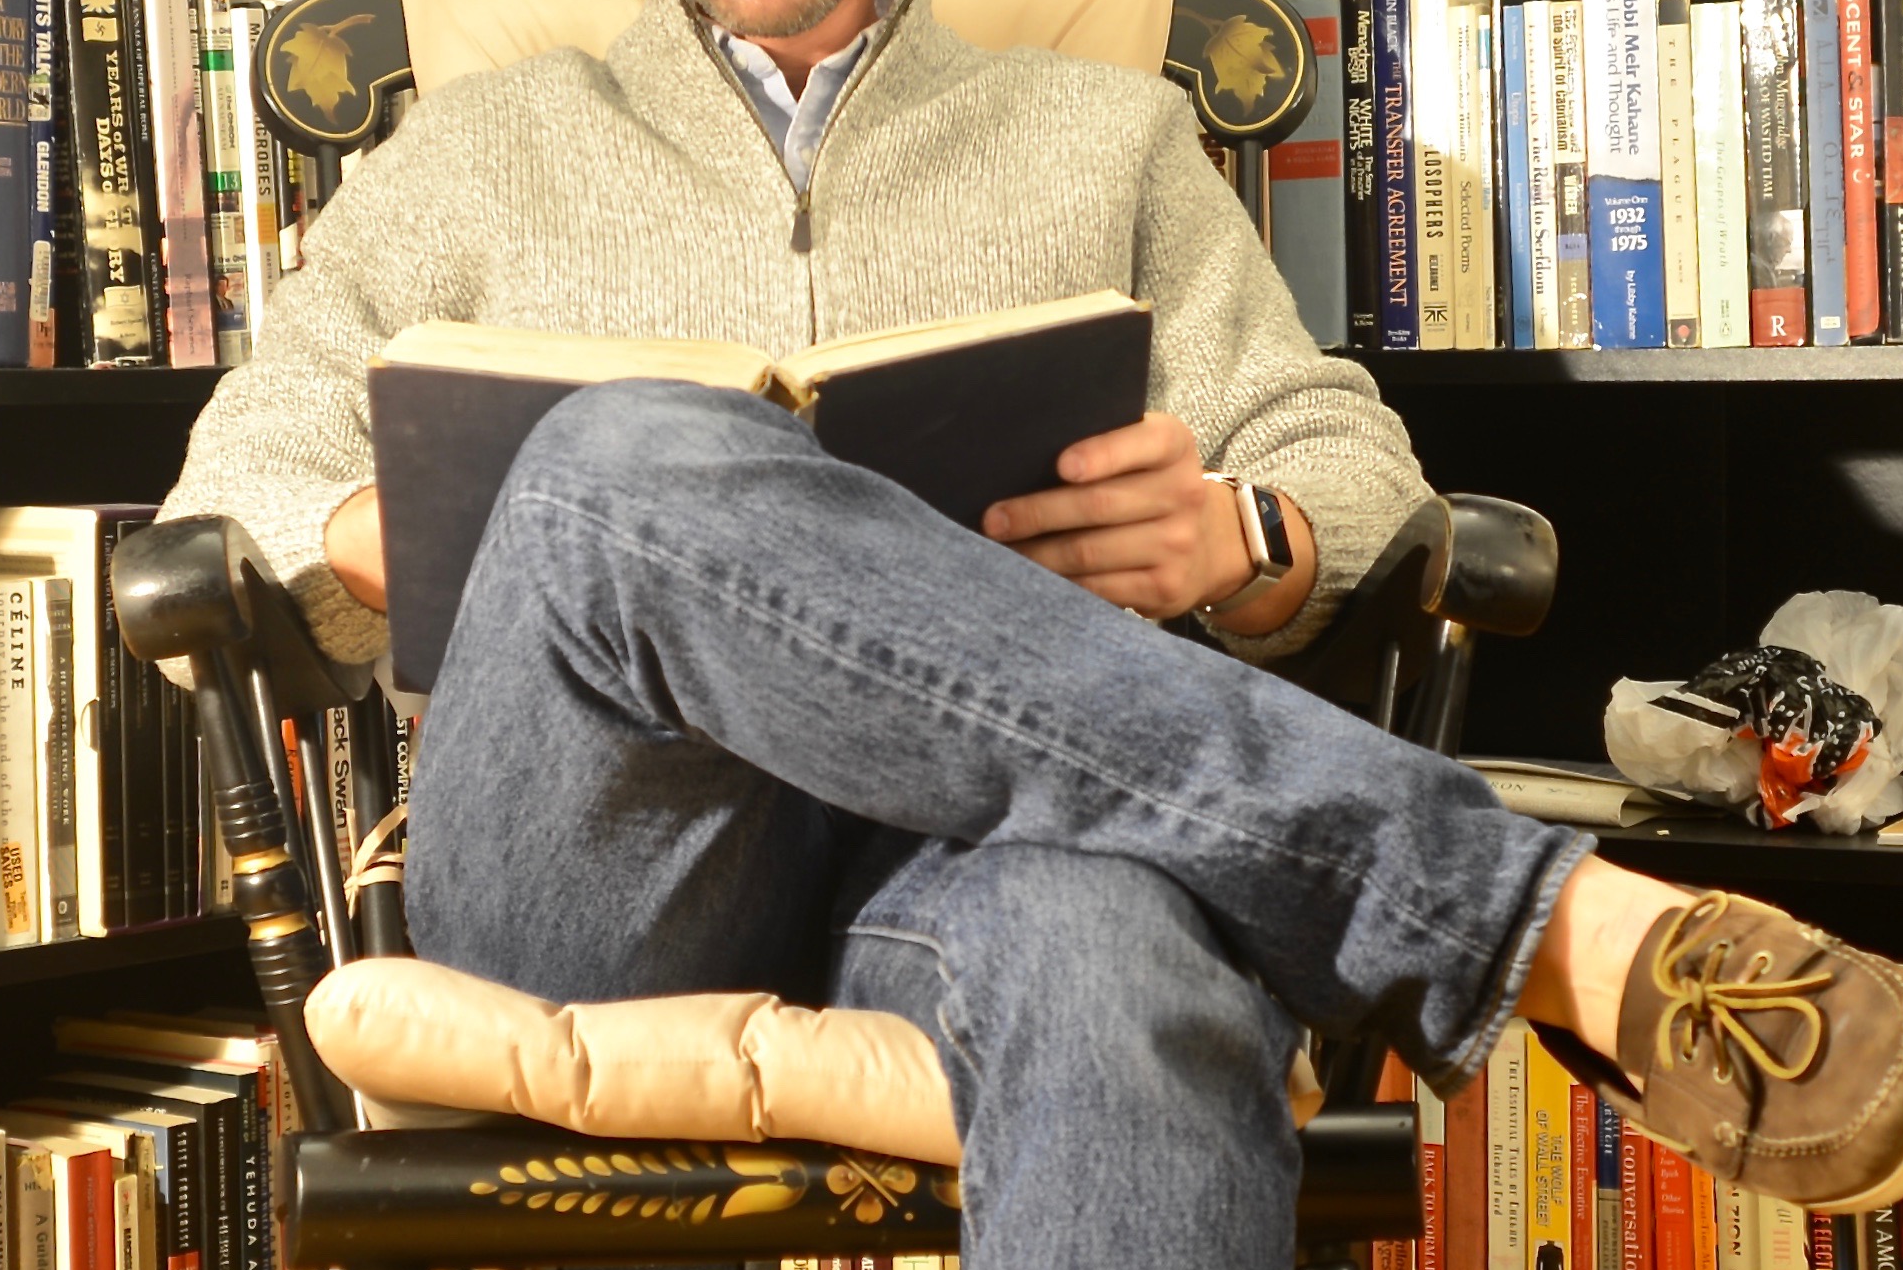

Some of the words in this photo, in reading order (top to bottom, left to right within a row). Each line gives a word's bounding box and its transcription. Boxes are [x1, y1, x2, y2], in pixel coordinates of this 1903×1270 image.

[1622, 33, 1638, 76] Meir
[1847, 72, 1862, 91] &
[1623, 83, 1639, 155] Kahane
[1848, 99, 1864, 159] STAR
[36, 141, 49, 212] GLENDON
[1610, 208, 1645, 223] 1932
[1611, 235, 1648, 251] 1975
[8, 592, 24, 689] CÉLINE
